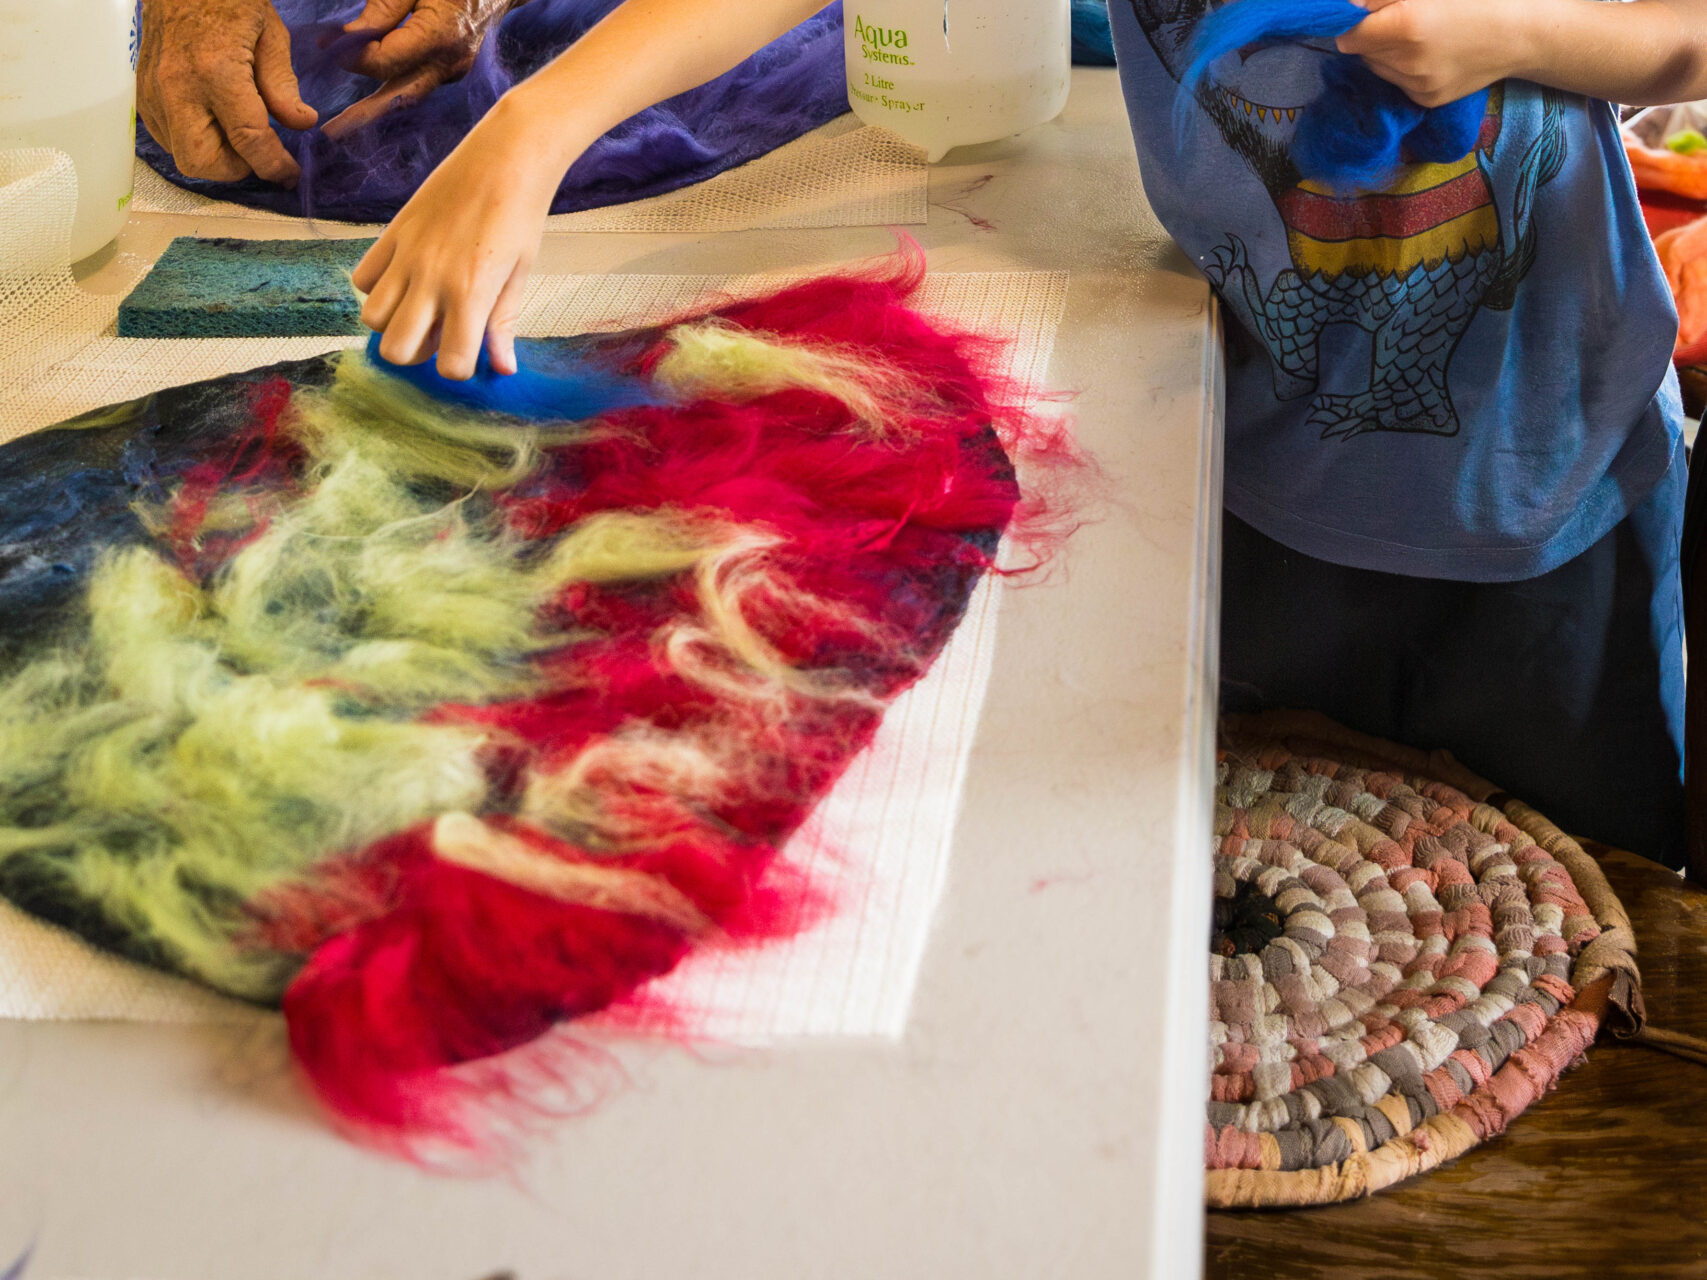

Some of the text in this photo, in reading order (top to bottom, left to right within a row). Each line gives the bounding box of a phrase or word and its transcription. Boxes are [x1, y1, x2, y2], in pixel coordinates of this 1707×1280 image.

[854, 14, 908, 50] Aqua
[861, 44, 910, 66] Systems
[864, 72, 895, 91] 2 Litre
[881, 95, 925, 113] Sprayer
